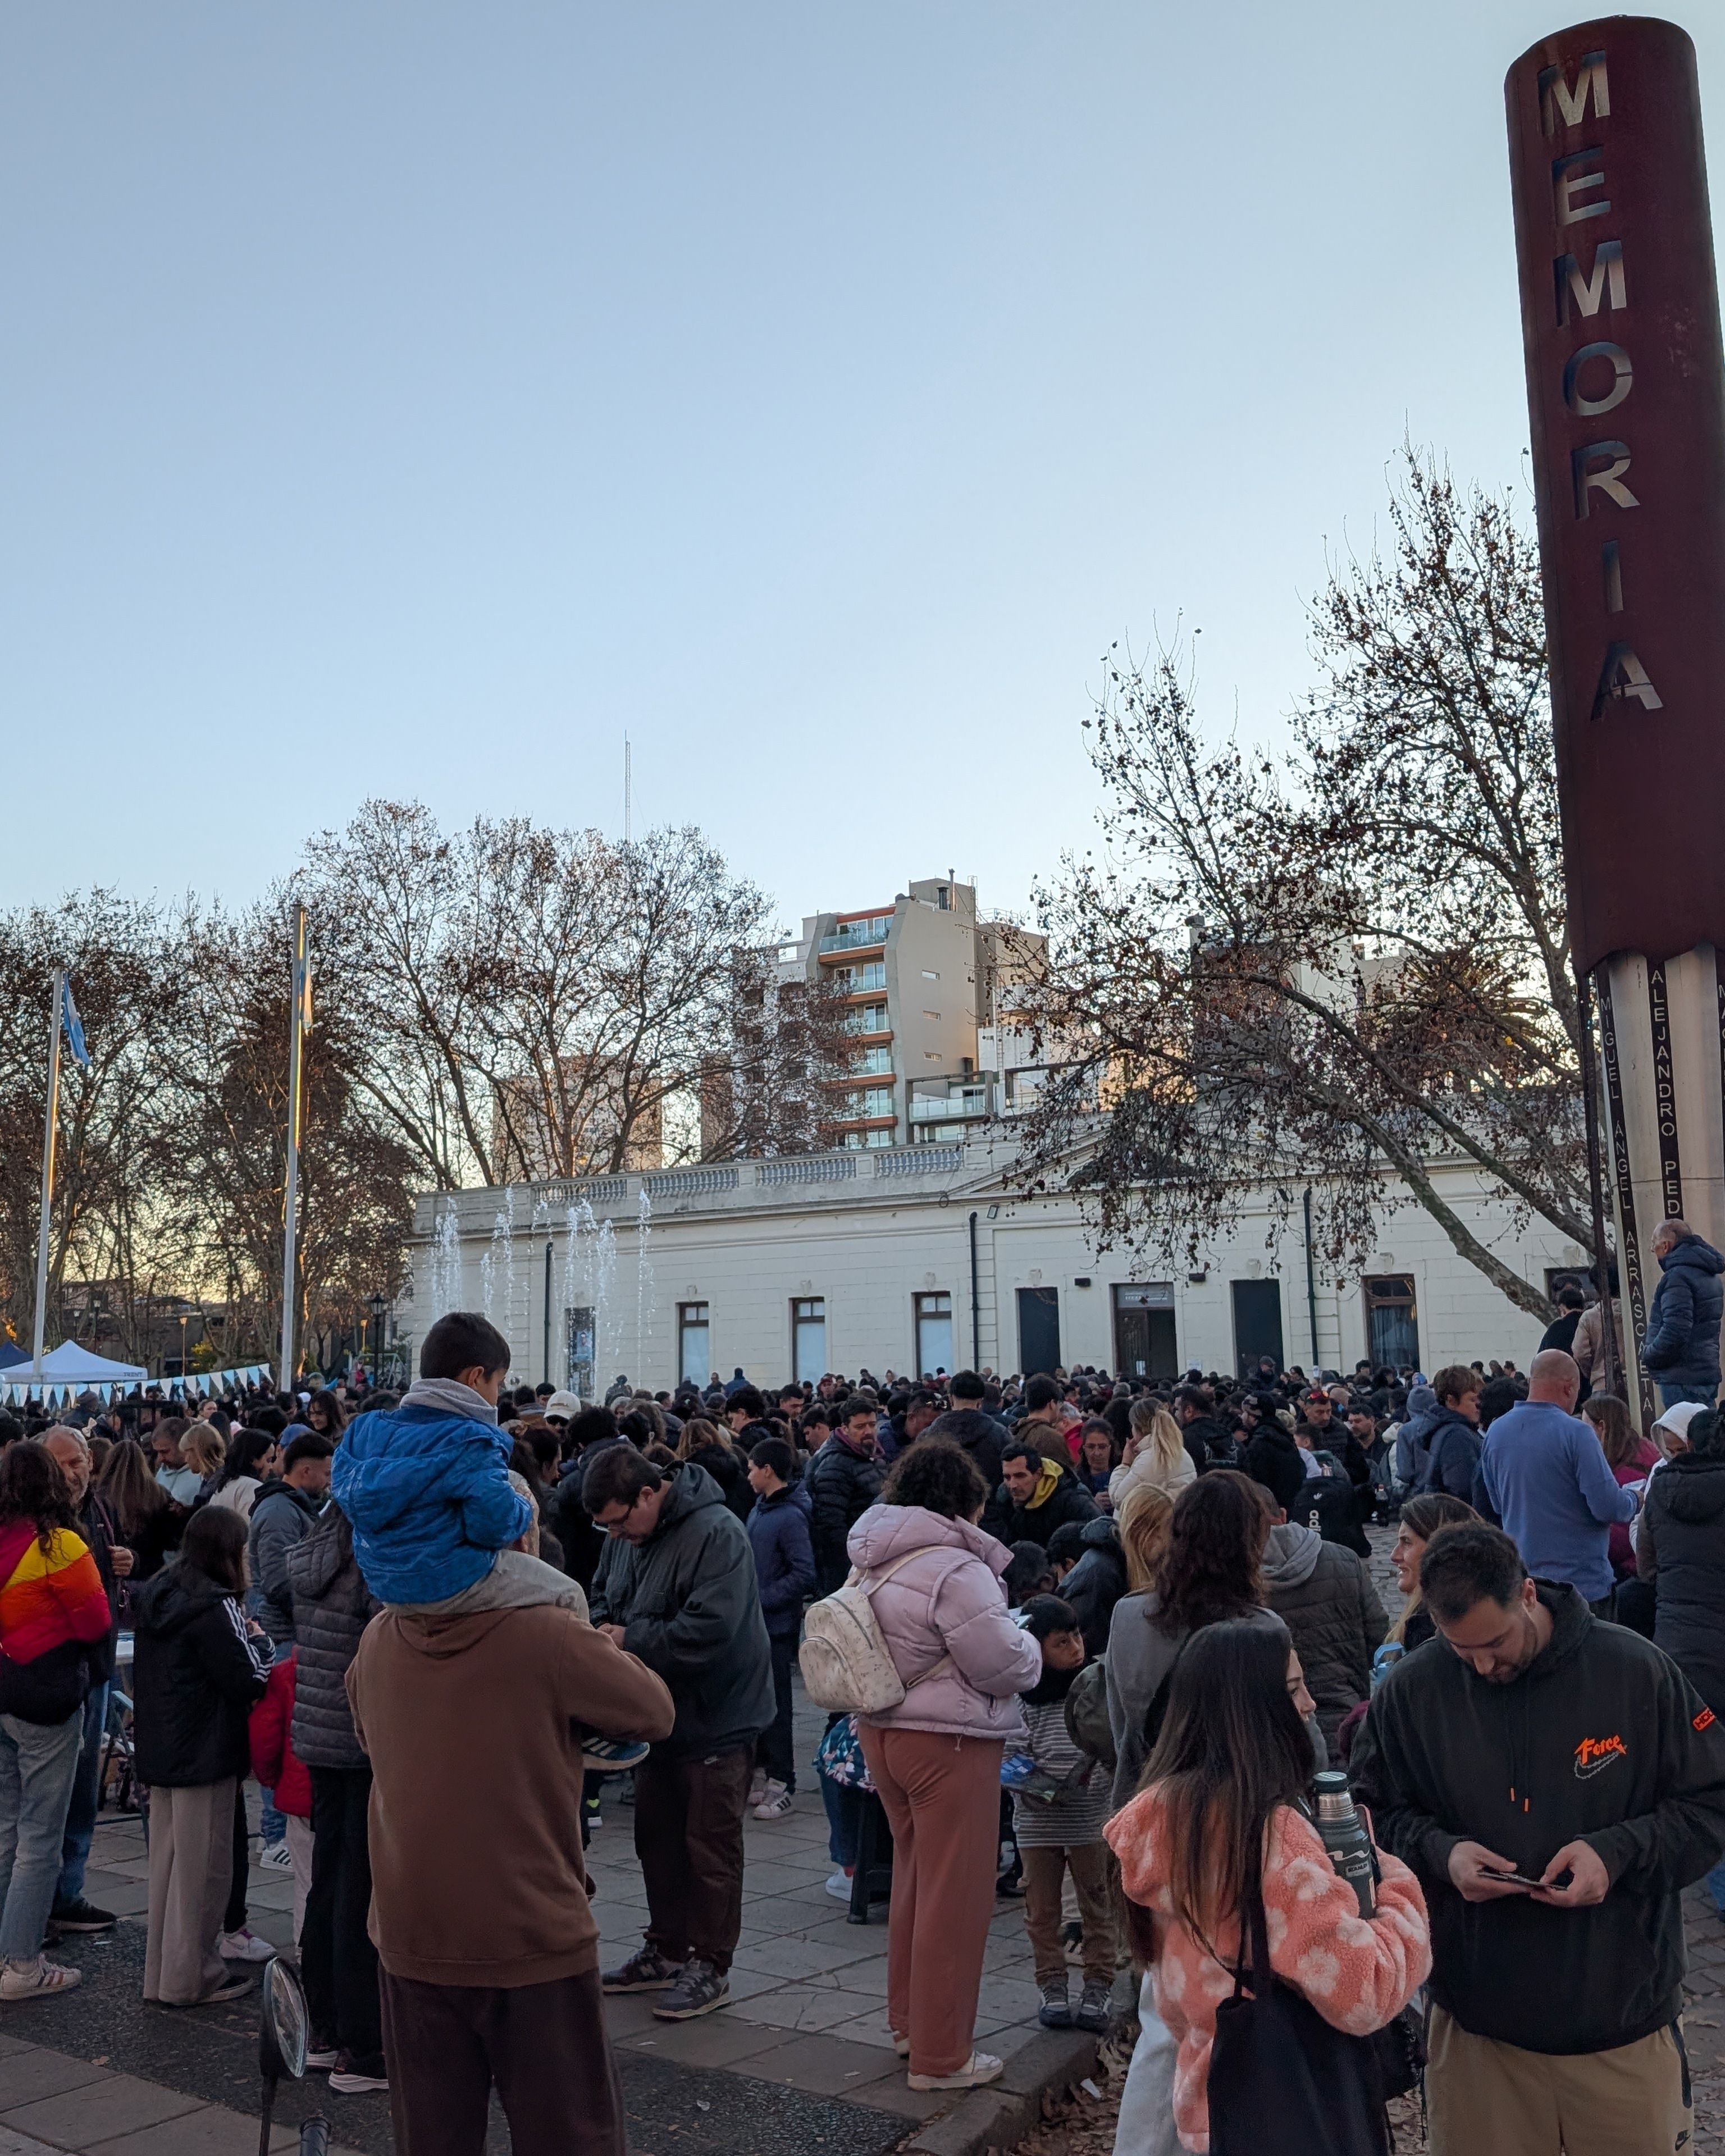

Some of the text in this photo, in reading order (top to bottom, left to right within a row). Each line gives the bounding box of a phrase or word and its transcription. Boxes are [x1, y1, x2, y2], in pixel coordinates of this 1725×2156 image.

[1537, 49, 1663, 722] MEMORIA
[1651, 970, 1675, 1137] ALEJANDRO
[1600, 997, 1619, 1099] MIGUEL
[1626, 1231, 1653, 1412] ARRASCAETA
[1574, 1734, 1627, 1765] Force
